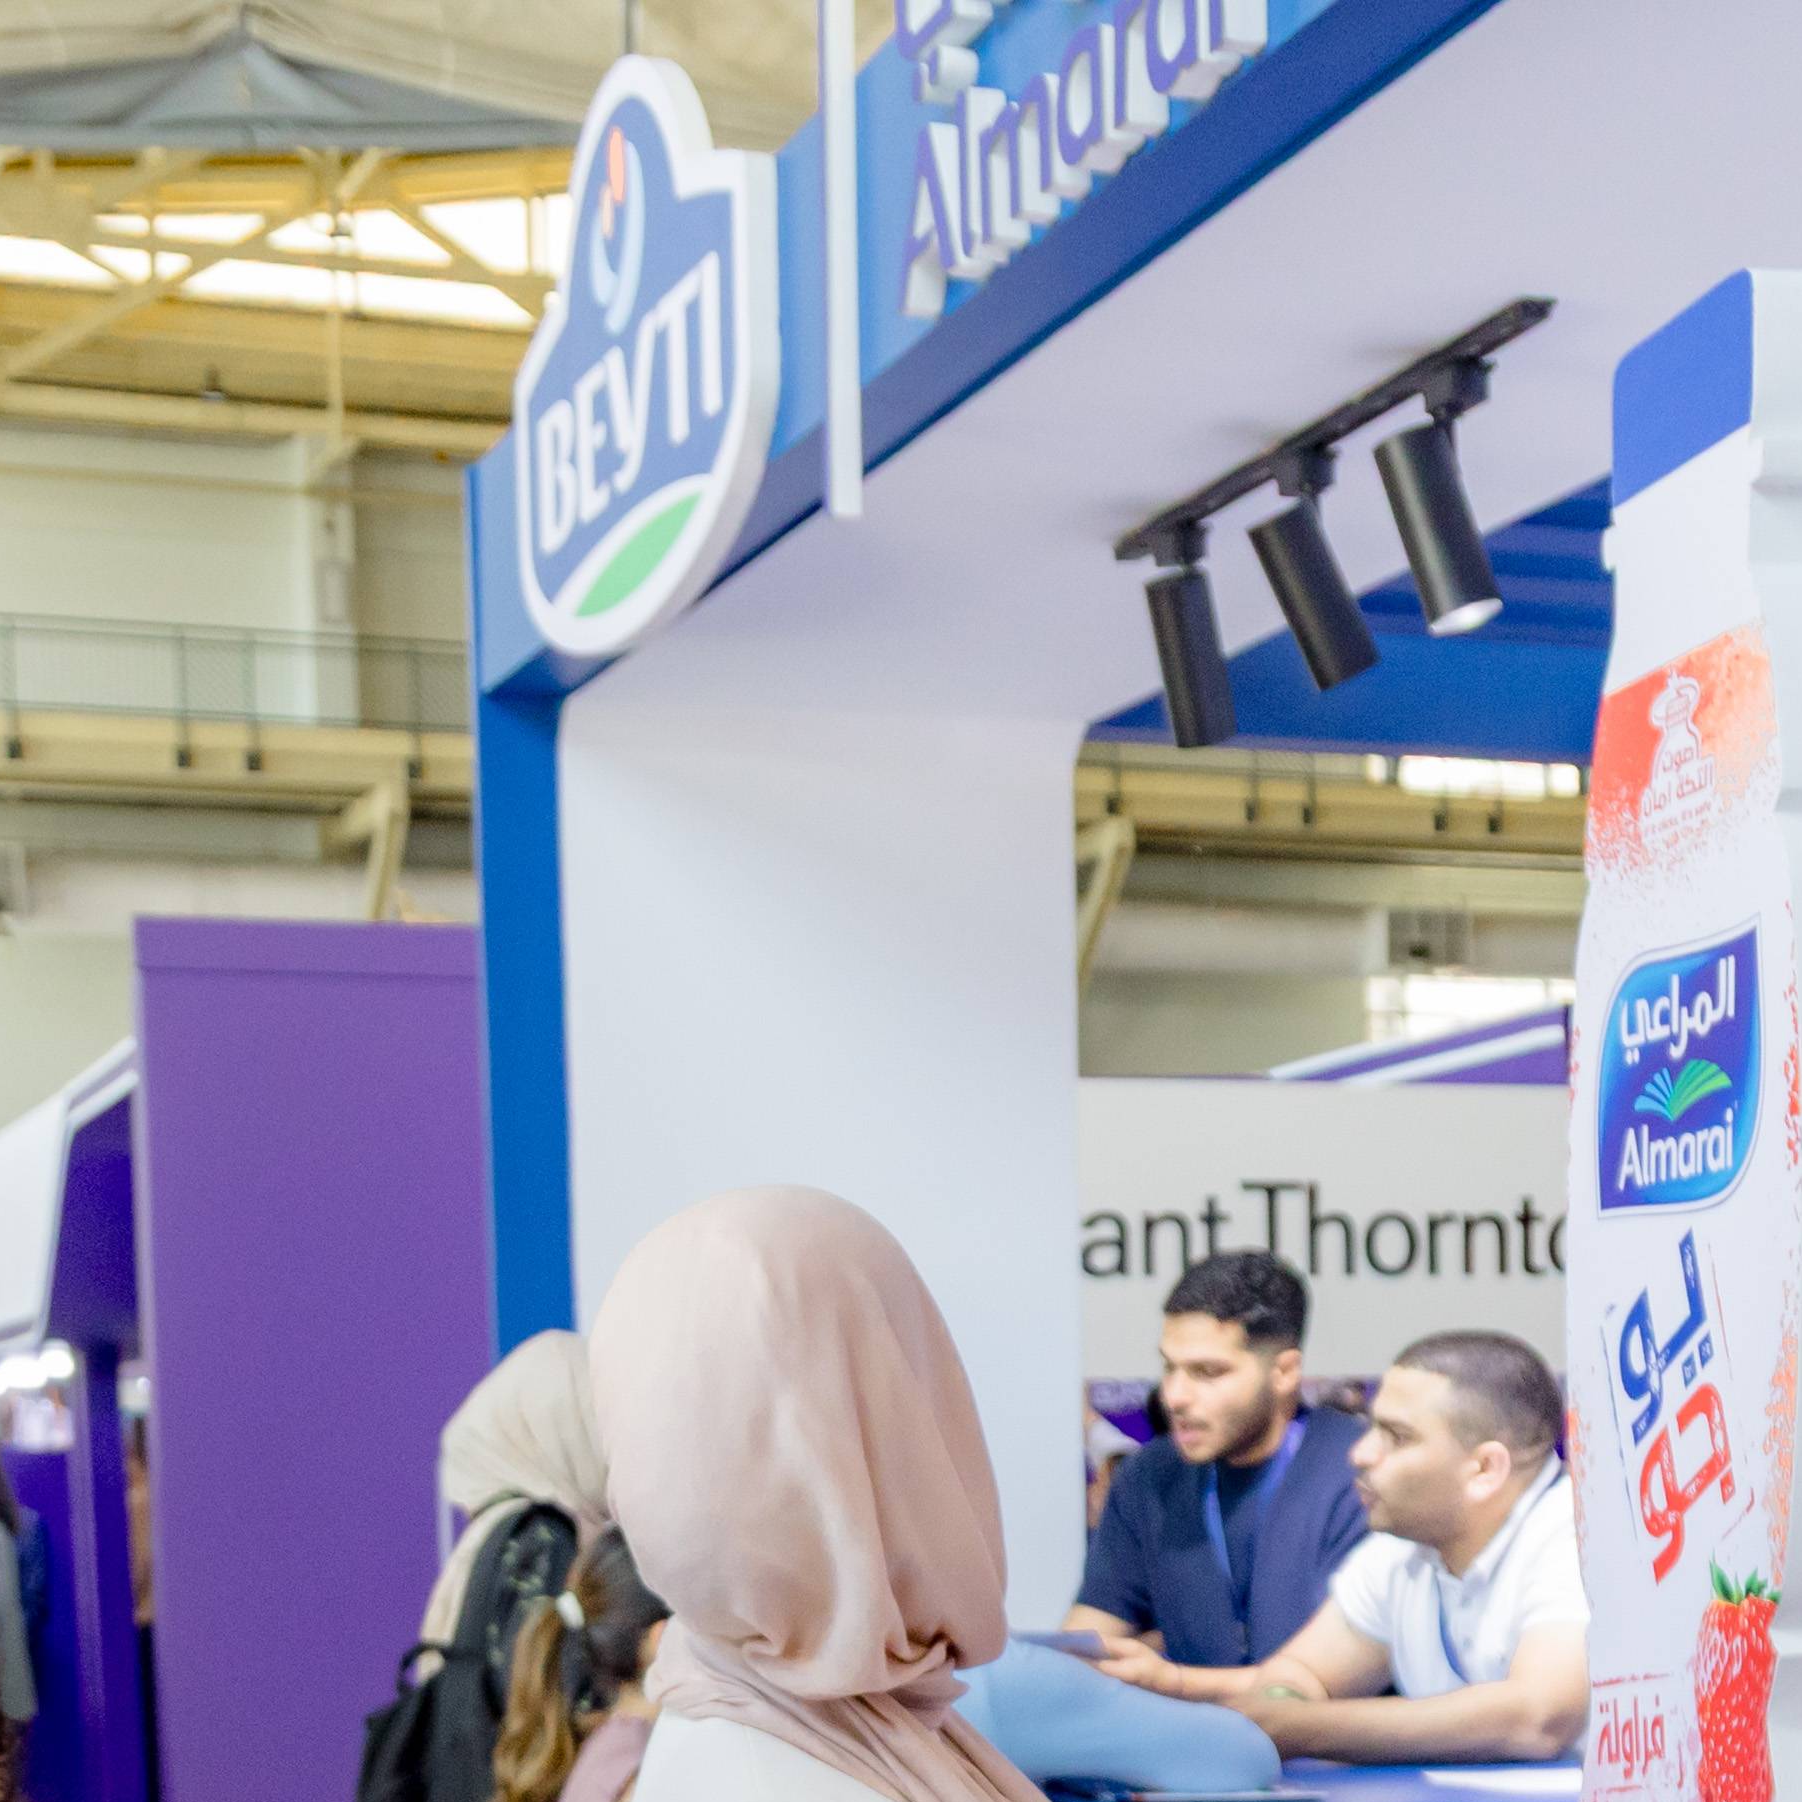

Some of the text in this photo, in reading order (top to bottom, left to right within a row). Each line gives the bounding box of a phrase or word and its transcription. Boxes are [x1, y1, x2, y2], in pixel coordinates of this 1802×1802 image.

[1620, 954, 1736, 1065] المراعي
[1618, 1107, 1734, 1191] Almarai
[1597, 1693, 1666, 1780] فراولة
